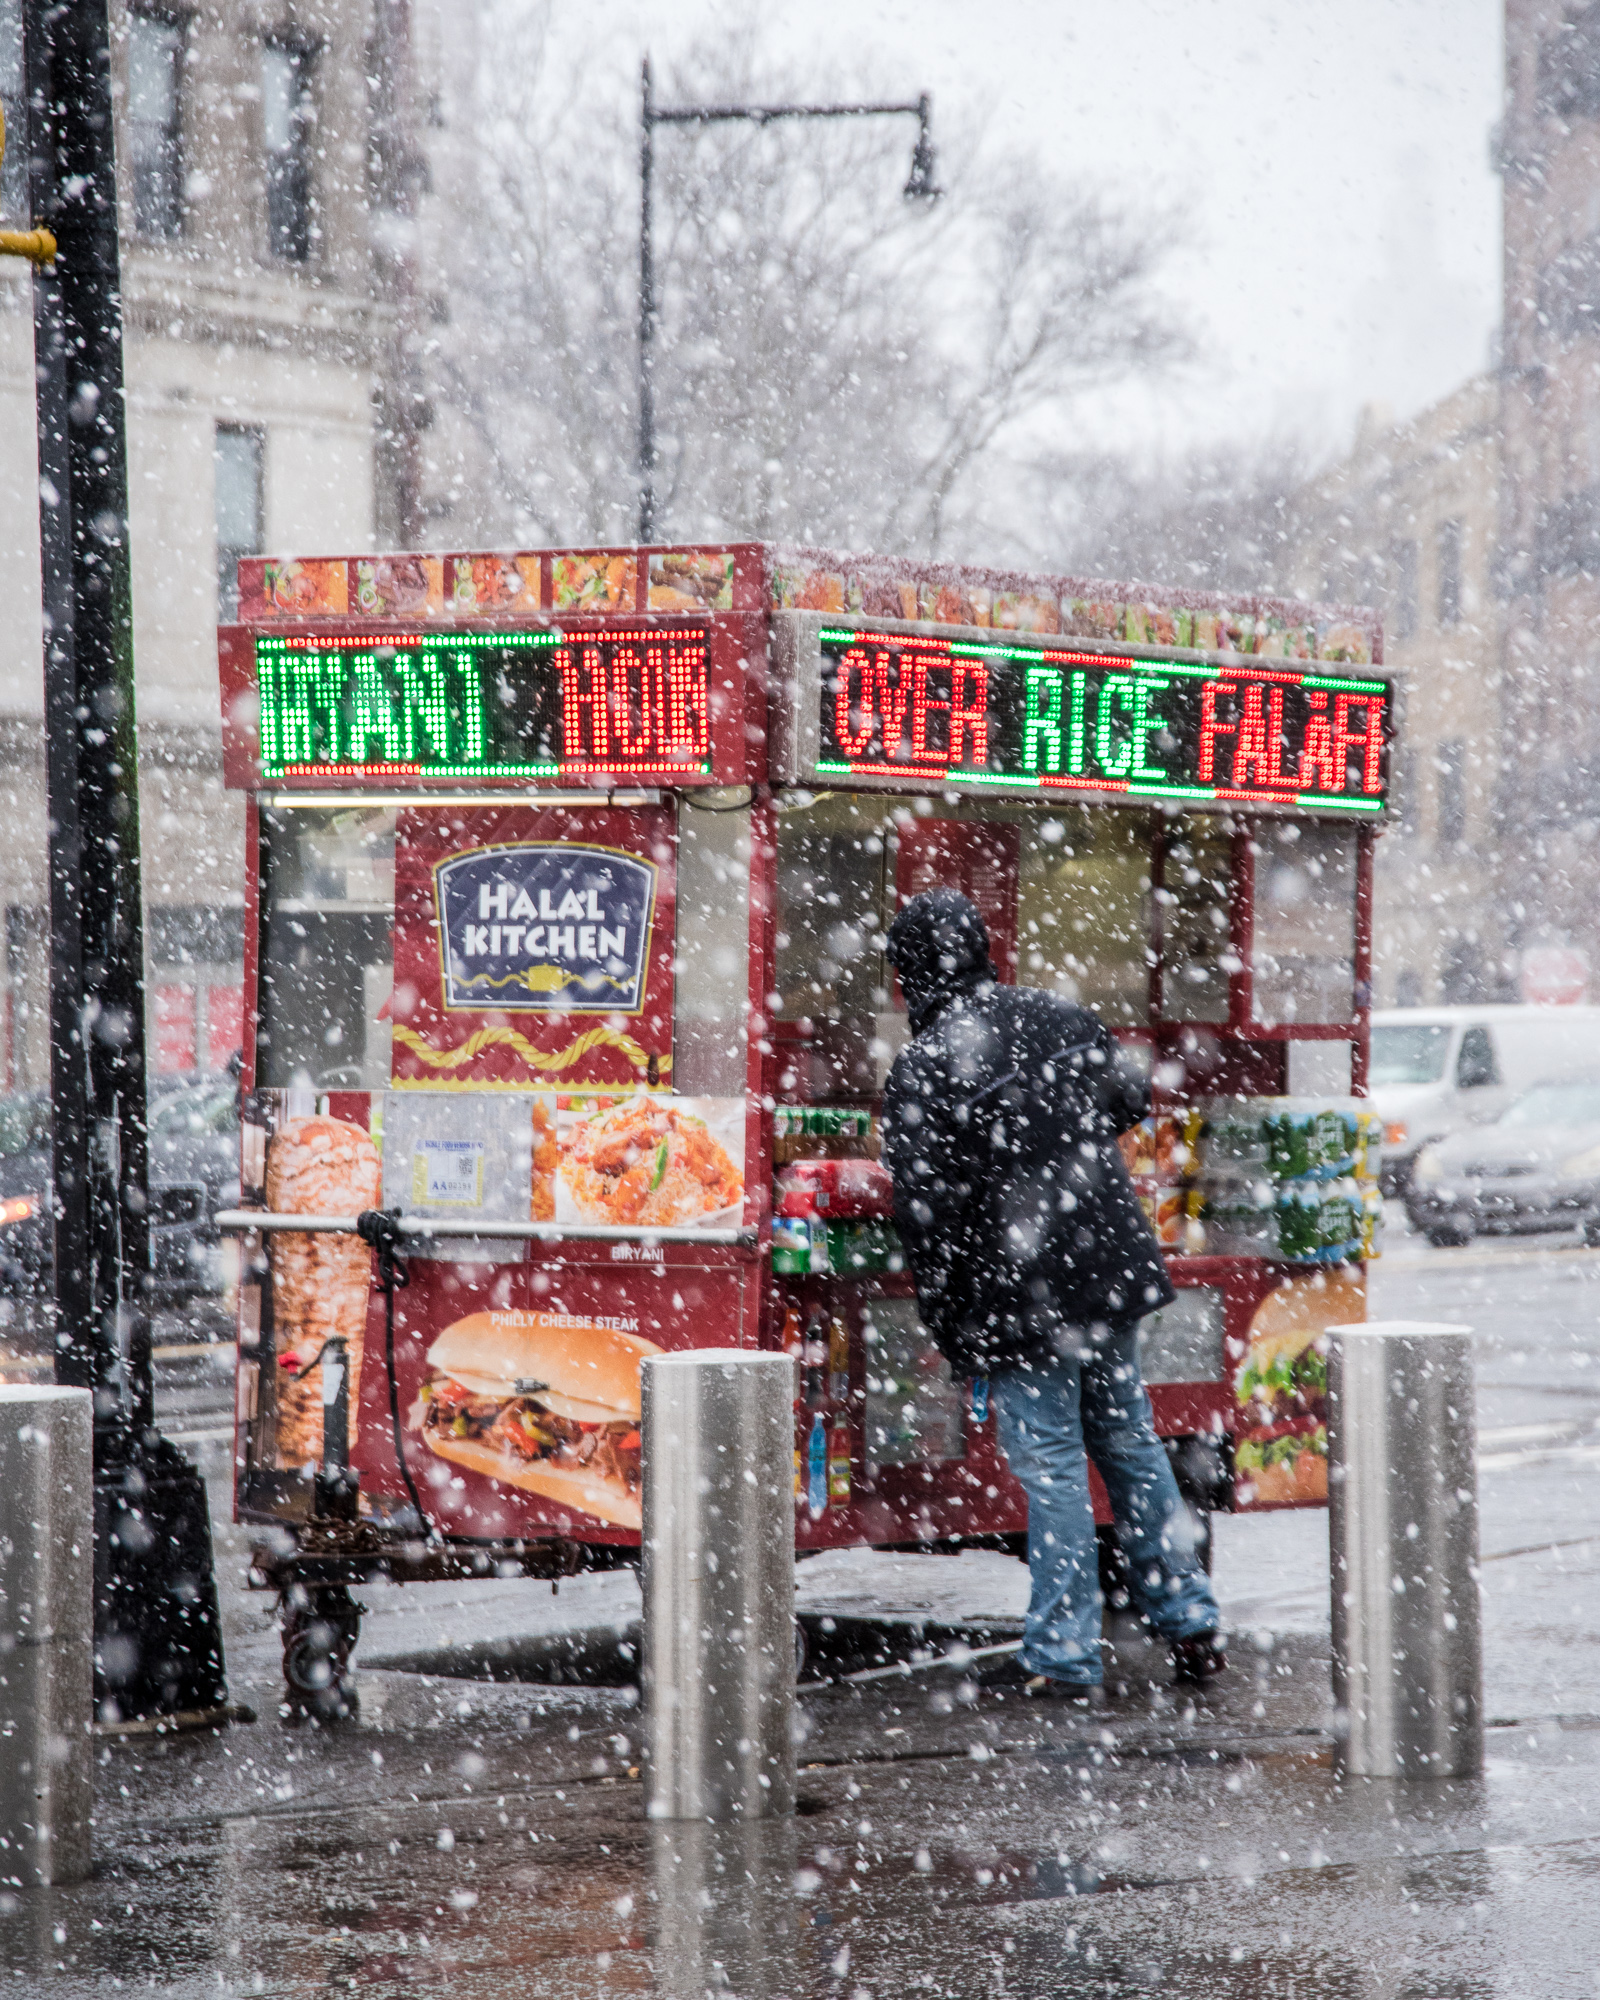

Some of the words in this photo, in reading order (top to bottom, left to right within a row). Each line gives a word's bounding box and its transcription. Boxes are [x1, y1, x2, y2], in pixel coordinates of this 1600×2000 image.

[834, 648, 989, 766] OVER
[1023, 666, 1171, 780] RICE
[478, 883, 605, 921] HALAL
[464, 924, 627, 958] KITCHEN
[611, 1246, 664, 1262] BIRYANI
[491, 1312, 536, 1328] PHILLY
[539, 1314, 593, 1331] CHEESE
[595, 1316, 640, 1332] STEAK
